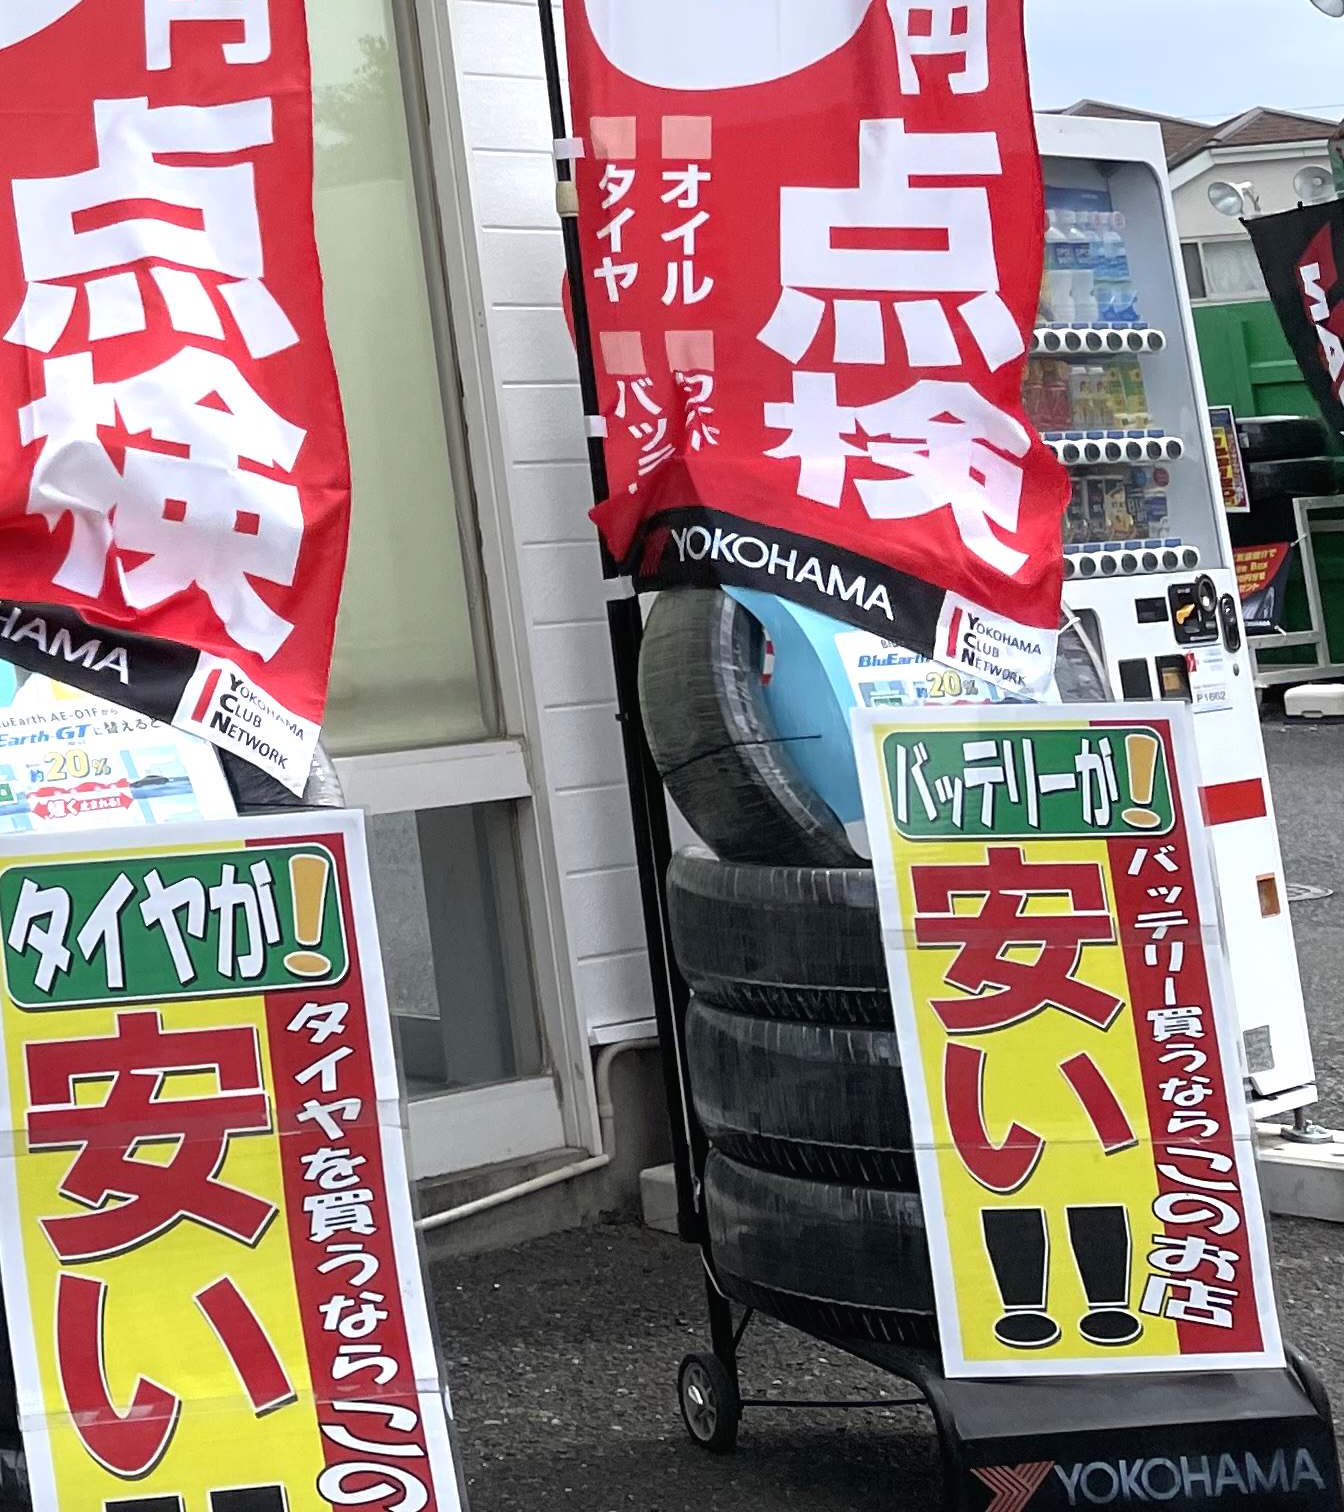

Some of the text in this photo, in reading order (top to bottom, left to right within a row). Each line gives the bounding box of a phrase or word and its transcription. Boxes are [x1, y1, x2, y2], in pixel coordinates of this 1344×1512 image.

[593, 164, 639, 304] タイヤ
[660, 164, 714, 306] オイル
[670, 525, 895, 622] YOKOHAMA
[963, 632, 1000, 659] CLUB
[967, 612, 1042, 656] YOKOHAMA
[961, 648, 1026, 687] NETWORK
[209, 710, 289, 770] NETWORK
[219, 693, 262, 729] CLUB
[1127, 844, 1241, 1329] バッテリー買うならこのお店
[1053, 1447, 1327, 1507] YOKOHAMA
